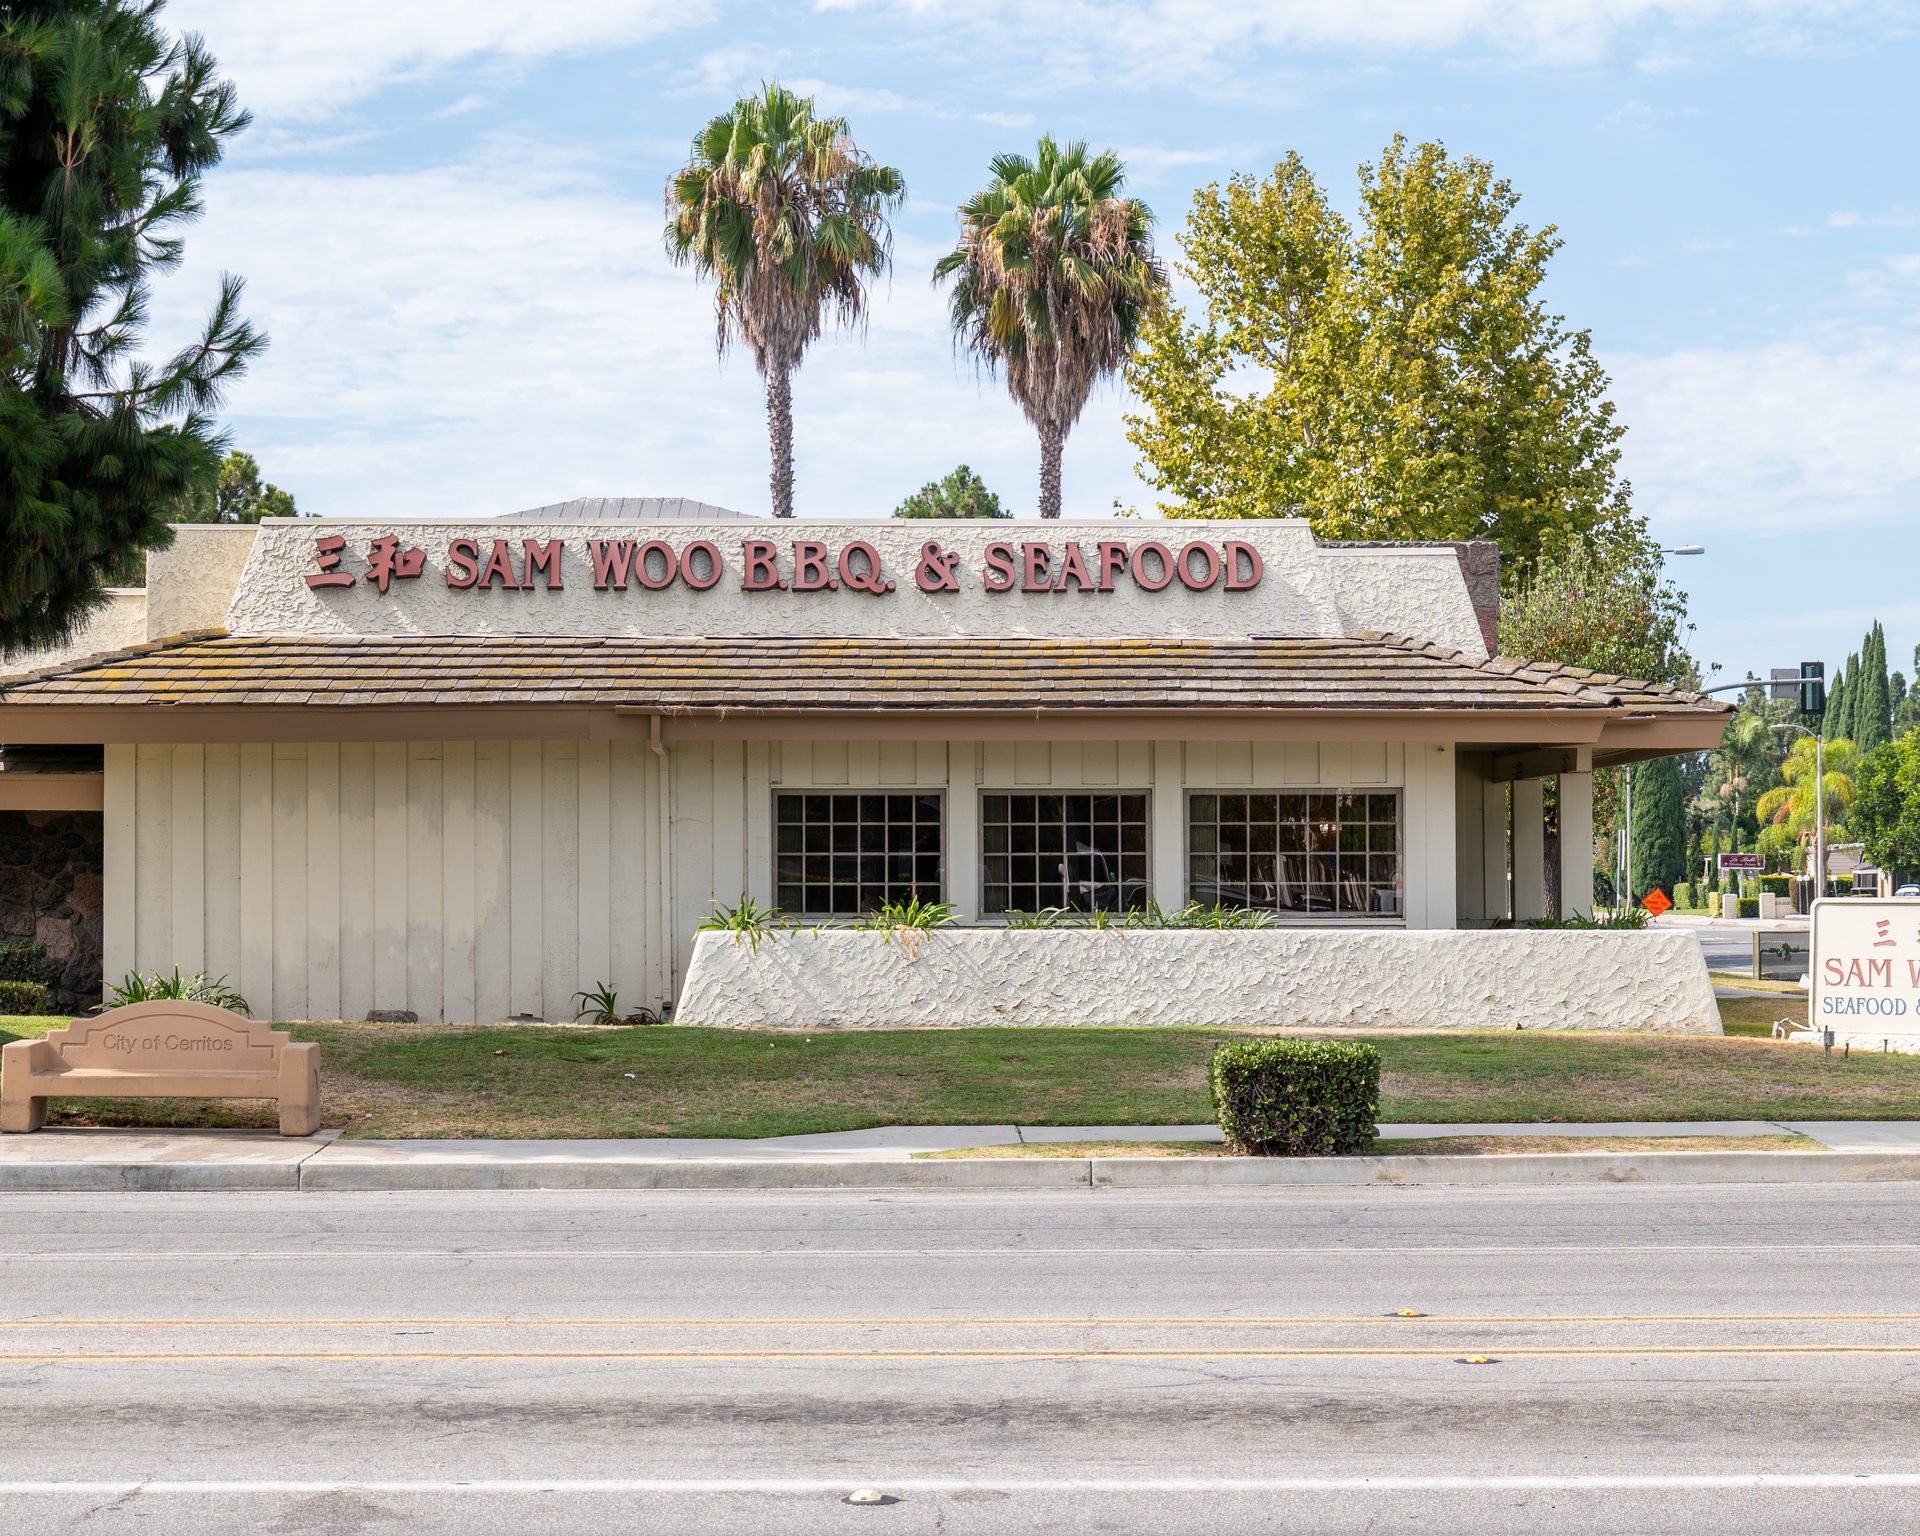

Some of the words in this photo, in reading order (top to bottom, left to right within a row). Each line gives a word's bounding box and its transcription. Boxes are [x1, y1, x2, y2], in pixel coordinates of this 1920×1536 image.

[305, 534, 427, 594] 三和
[446, 538, 564, 591] SAM
[586, 539, 724, 591] WOO
[741, 540, 897, 596] B.B.Q.
[915, 541, 960, 593] &
[983, 540, 1264, 593] SEAFOOD
[1824, 957, 1894, 988] SAM
[1823, 996, 1908, 1016] SEAFOOD
[103, 1034, 137, 1054] City
[142, 1035, 161, 1051] of
[165, 1035, 233, 1051] Cerritos
